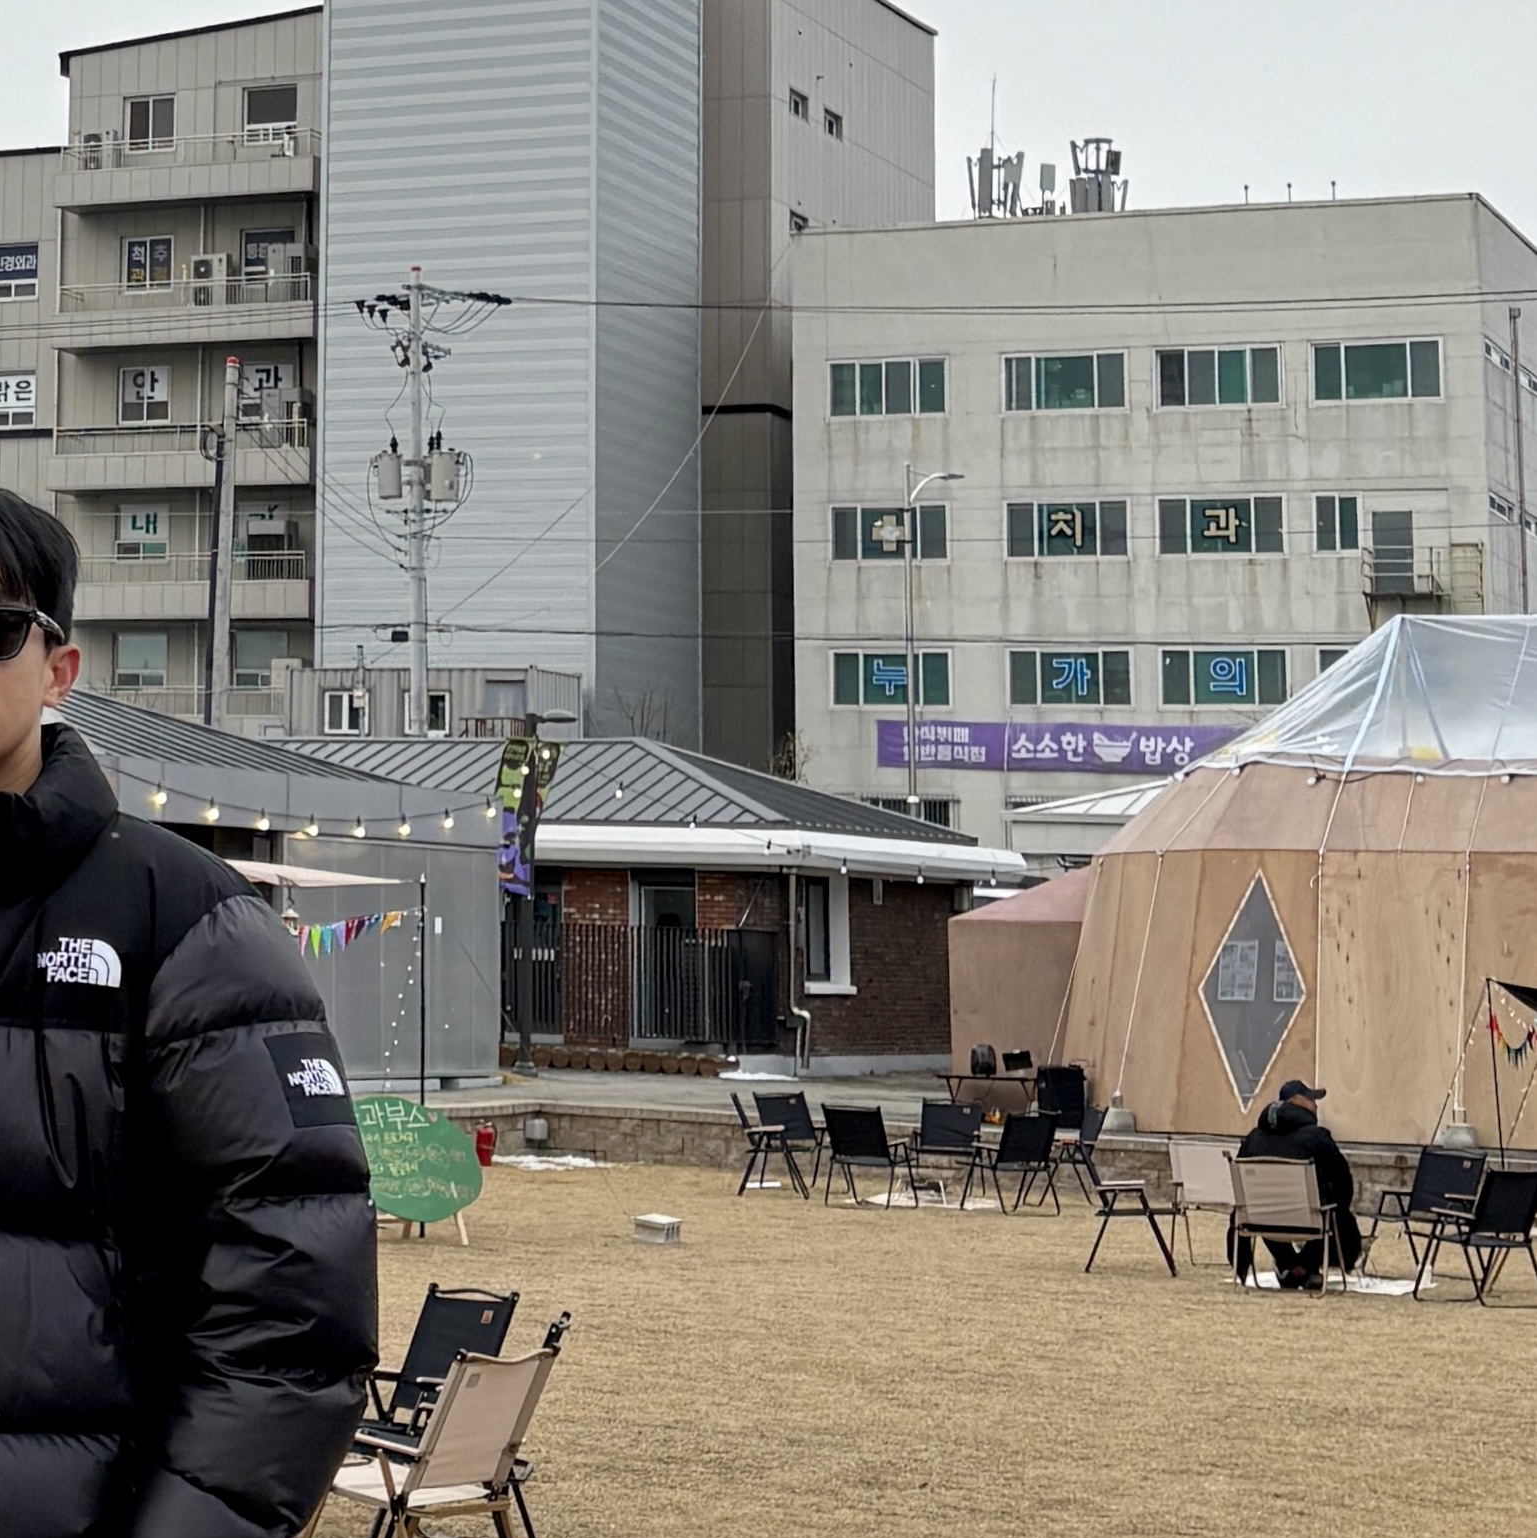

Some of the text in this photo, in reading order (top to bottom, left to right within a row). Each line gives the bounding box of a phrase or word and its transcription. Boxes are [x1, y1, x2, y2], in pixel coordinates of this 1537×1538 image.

[133, 370, 159, 400] 안
[1049, 507, 1239, 548] 치 과
[1052, 658, 1091, 696] 가
[1209, 658, 1247, 696] 의
[1011, 732, 1195, 766] 소소한 밥상
[58, 937, 93, 953] THE
[37, 951, 91, 969] NORTH
[46, 967, 89, 984] FACE
[301, 1058, 323, 1073] THE
[287, 1069, 325, 1088] NORTH
[303, 1082, 331, 1097] FACE
[354, 1100, 430, 1131] 과부스
